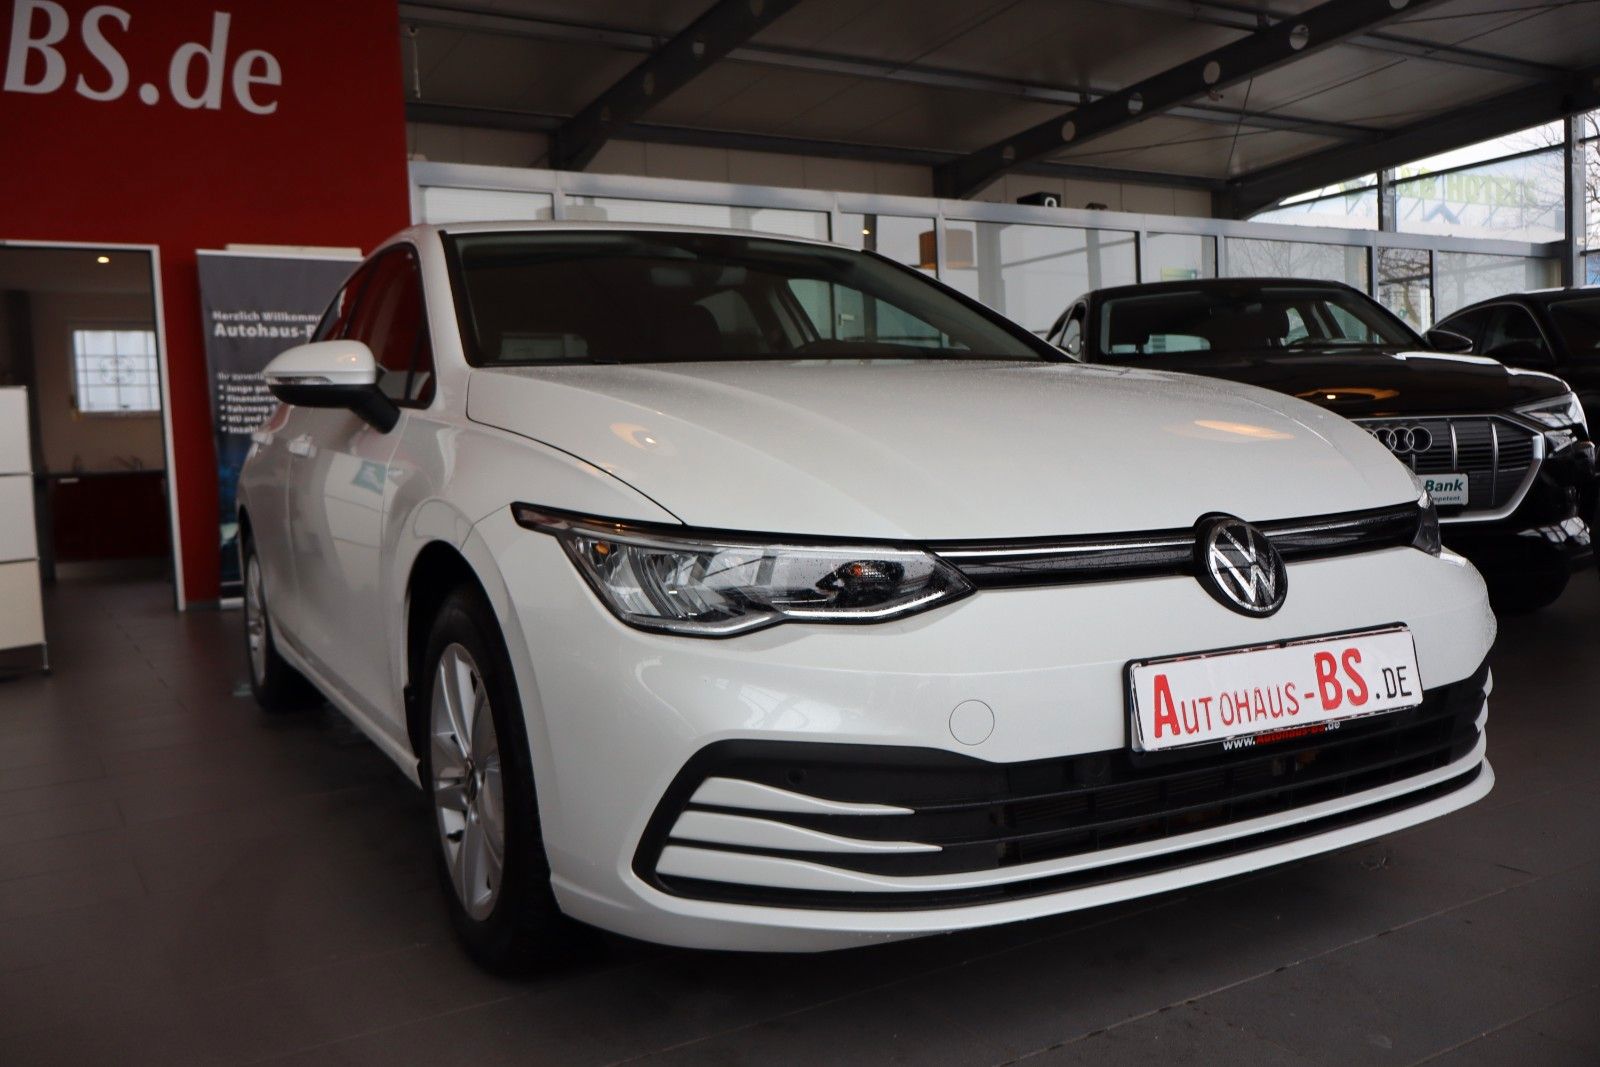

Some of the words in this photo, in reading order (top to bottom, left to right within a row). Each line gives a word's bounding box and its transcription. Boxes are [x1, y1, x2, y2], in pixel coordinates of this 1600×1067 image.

[3, 0, 283, 115] BS.de
[212, 311, 260, 321] Herzlich
[1425, 478, 1464, 492] Bank
